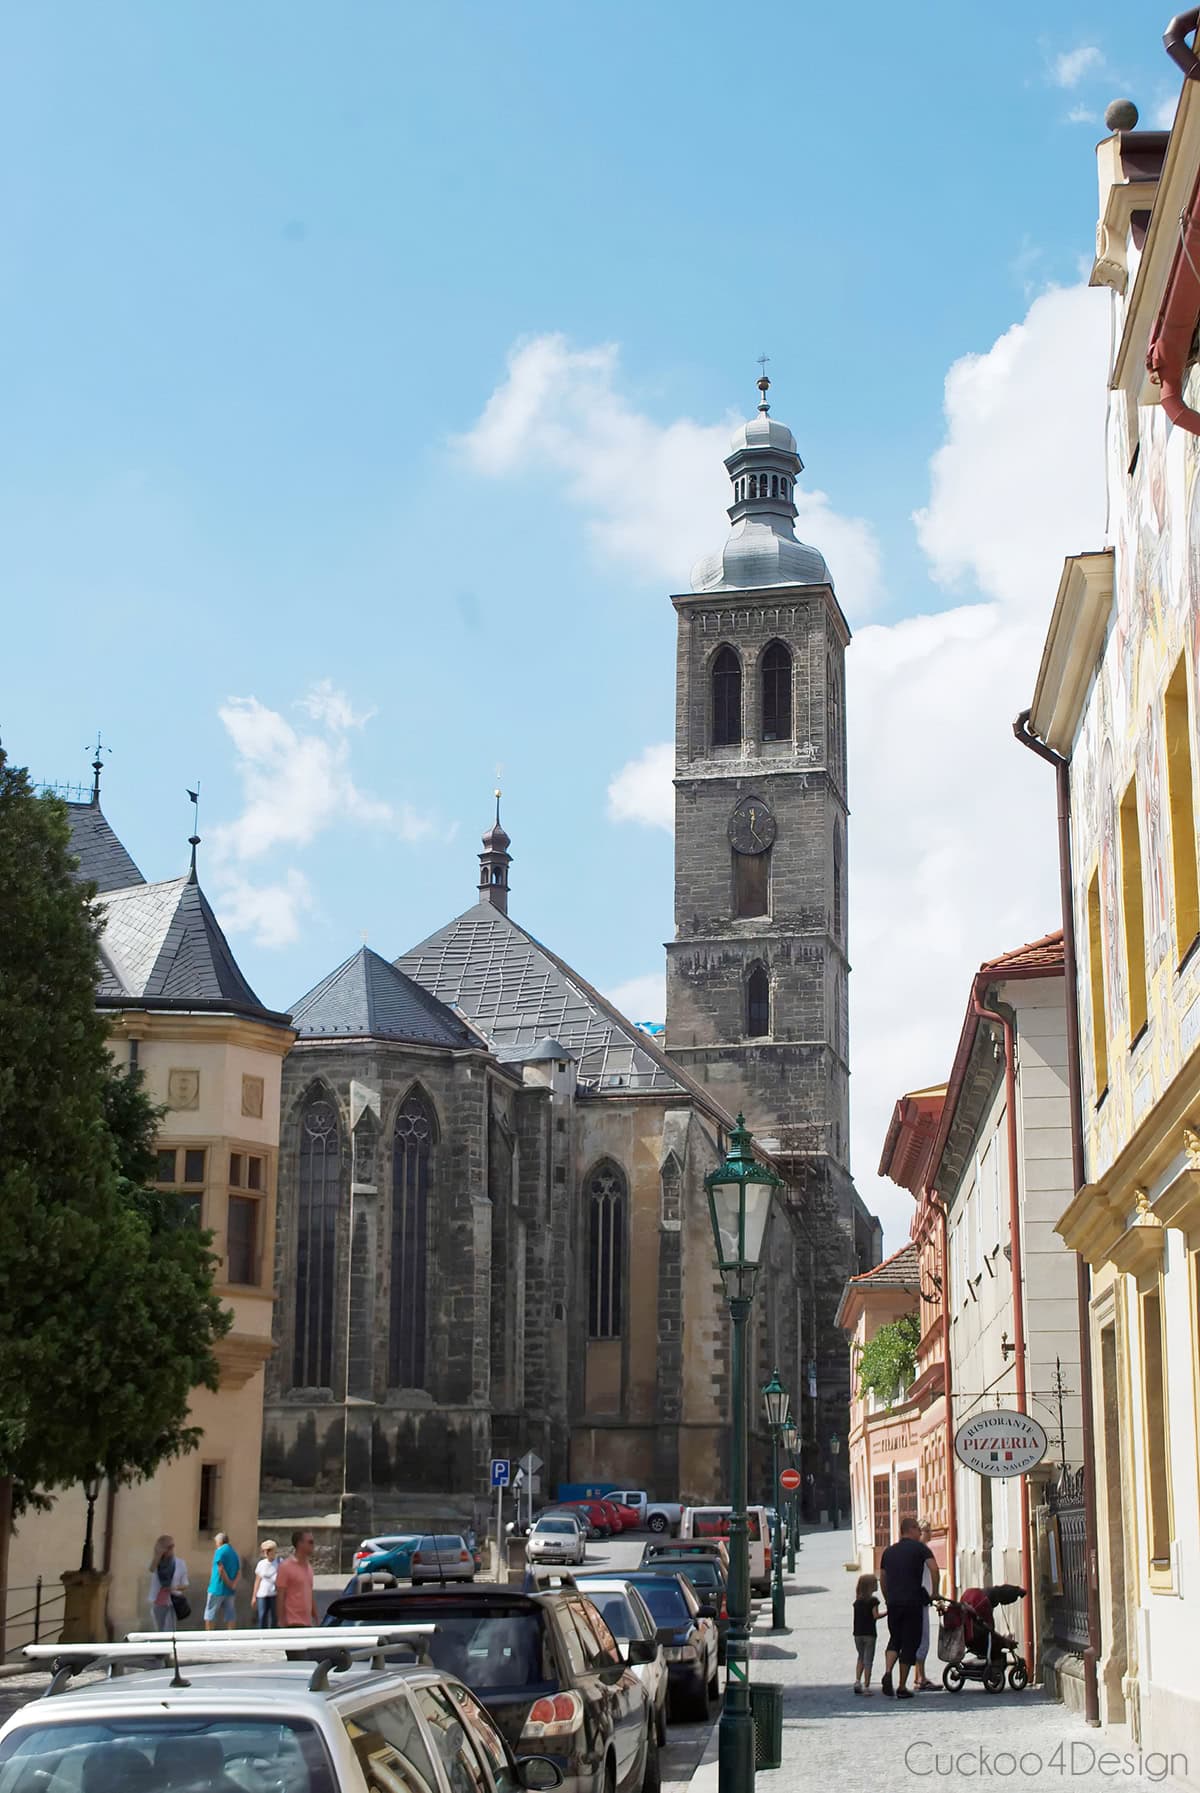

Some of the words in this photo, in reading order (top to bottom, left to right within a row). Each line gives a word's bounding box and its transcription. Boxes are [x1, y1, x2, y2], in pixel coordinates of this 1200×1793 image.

[967, 1417, 1034, 1437] RISTORANTE
[963, 1436, 1039, 1451] PIZZERIA
[494, 1463, 506, 1478] P
[970, 1456, 1000, 1472] PIAZZA
